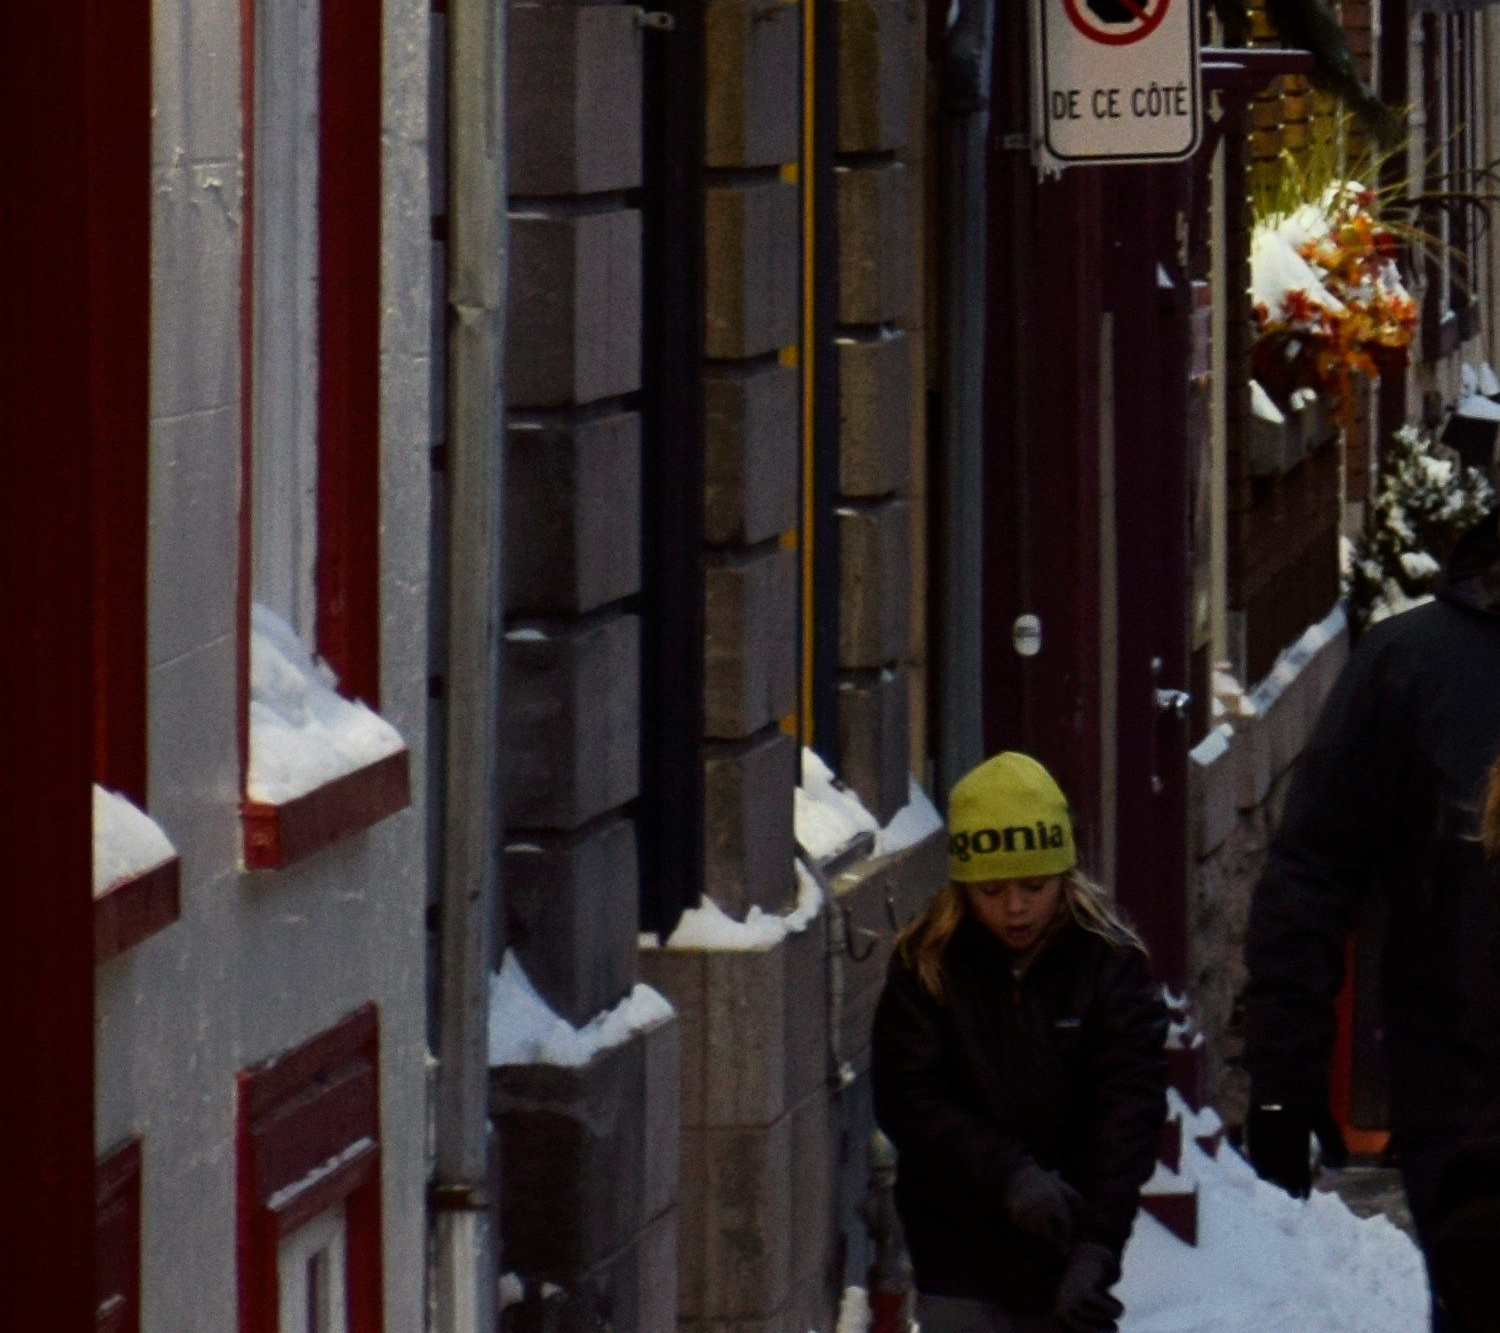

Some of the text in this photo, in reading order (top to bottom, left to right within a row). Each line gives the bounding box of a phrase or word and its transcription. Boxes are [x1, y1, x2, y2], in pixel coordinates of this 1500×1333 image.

[1051, 81, 1188, 120] DE CE CÔTÉ
